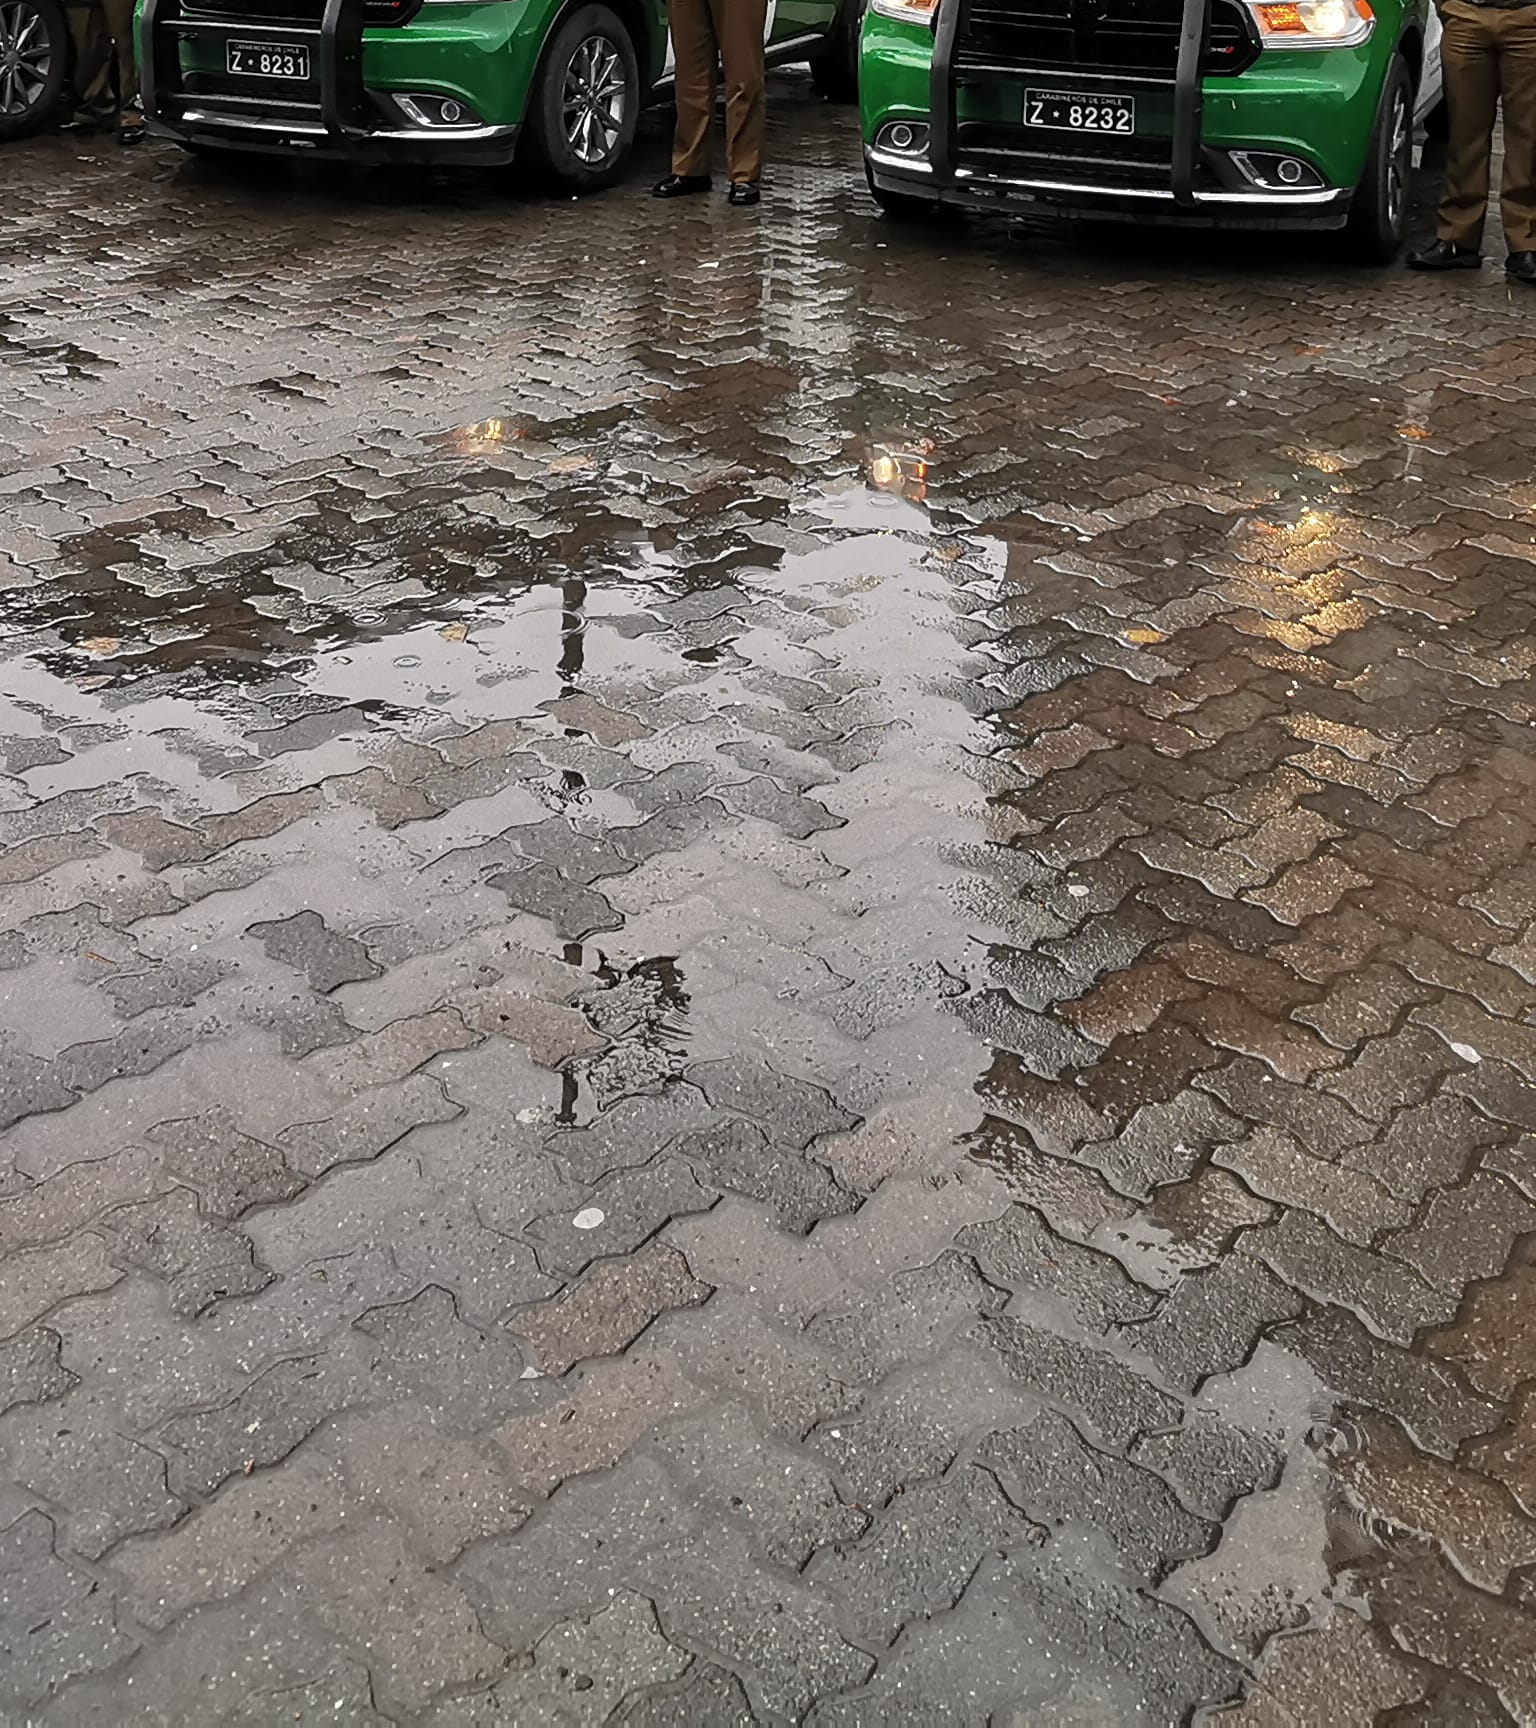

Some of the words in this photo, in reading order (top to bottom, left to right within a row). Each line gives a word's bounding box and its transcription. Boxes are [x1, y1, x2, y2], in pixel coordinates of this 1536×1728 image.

[231, 51, 243, 72] Z
[260, 53, 305, 76] 8231
[1030, 101, 1044, 123] Z
[1069, 105, 1130, 131] 8232
